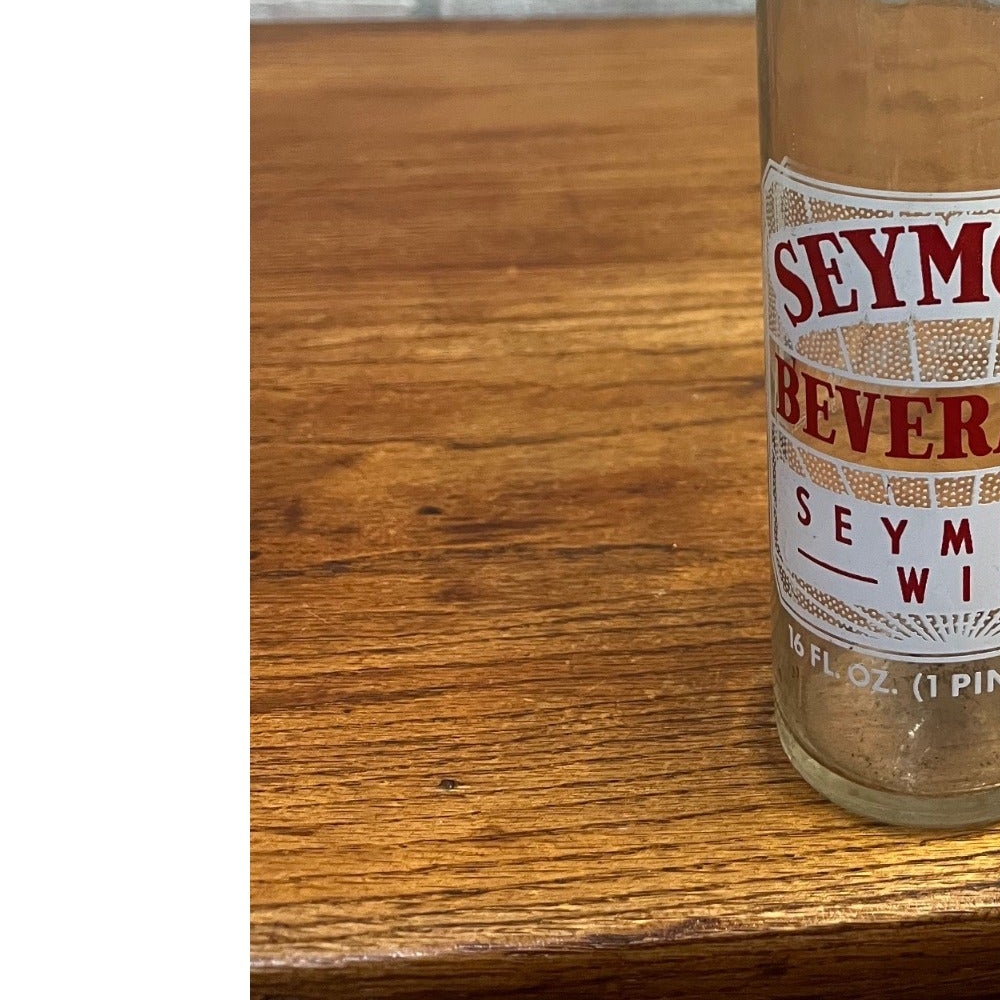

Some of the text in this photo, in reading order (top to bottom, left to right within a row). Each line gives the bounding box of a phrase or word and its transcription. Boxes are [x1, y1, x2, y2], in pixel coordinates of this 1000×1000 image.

[788, 624, 805, 658] 16
[810, 643, 841, 679] FL.
[847, 663, 898, 695] OZ.
[912, 672, 938, 702] (1
